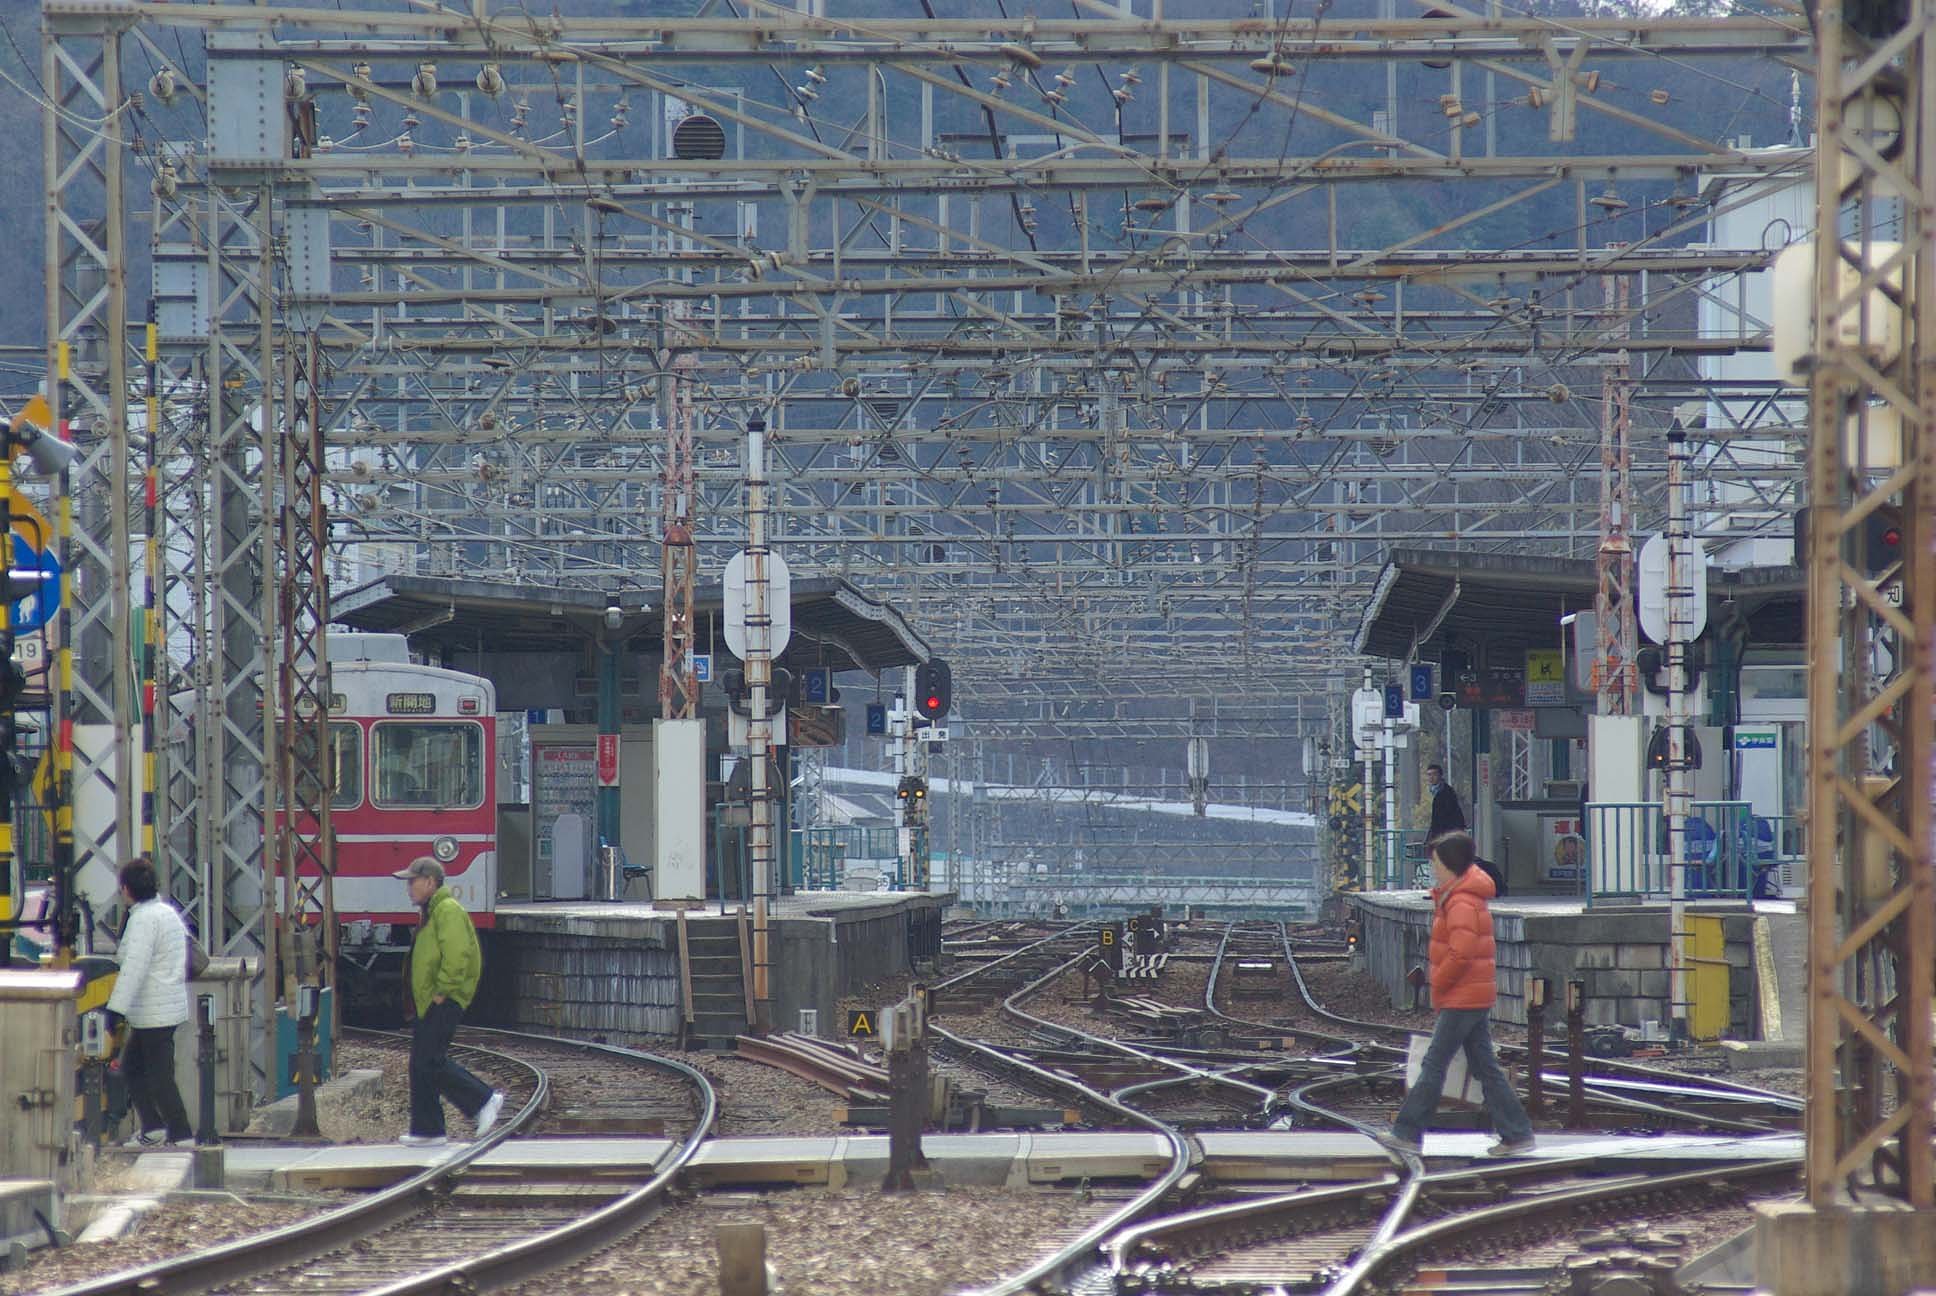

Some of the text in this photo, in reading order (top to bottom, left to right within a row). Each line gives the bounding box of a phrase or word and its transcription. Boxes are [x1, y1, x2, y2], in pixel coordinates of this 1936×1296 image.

[16, 642, 37, 659] 19
[811, 678, 823, 695] 2
[1415, 674, 1427, 693] 3
[1389, 693, 1400, 710] 3
[871, 711, 882, 728] 2
[1103, 929, 1113, 946] B
[851, 1012, 873, 1035] A
